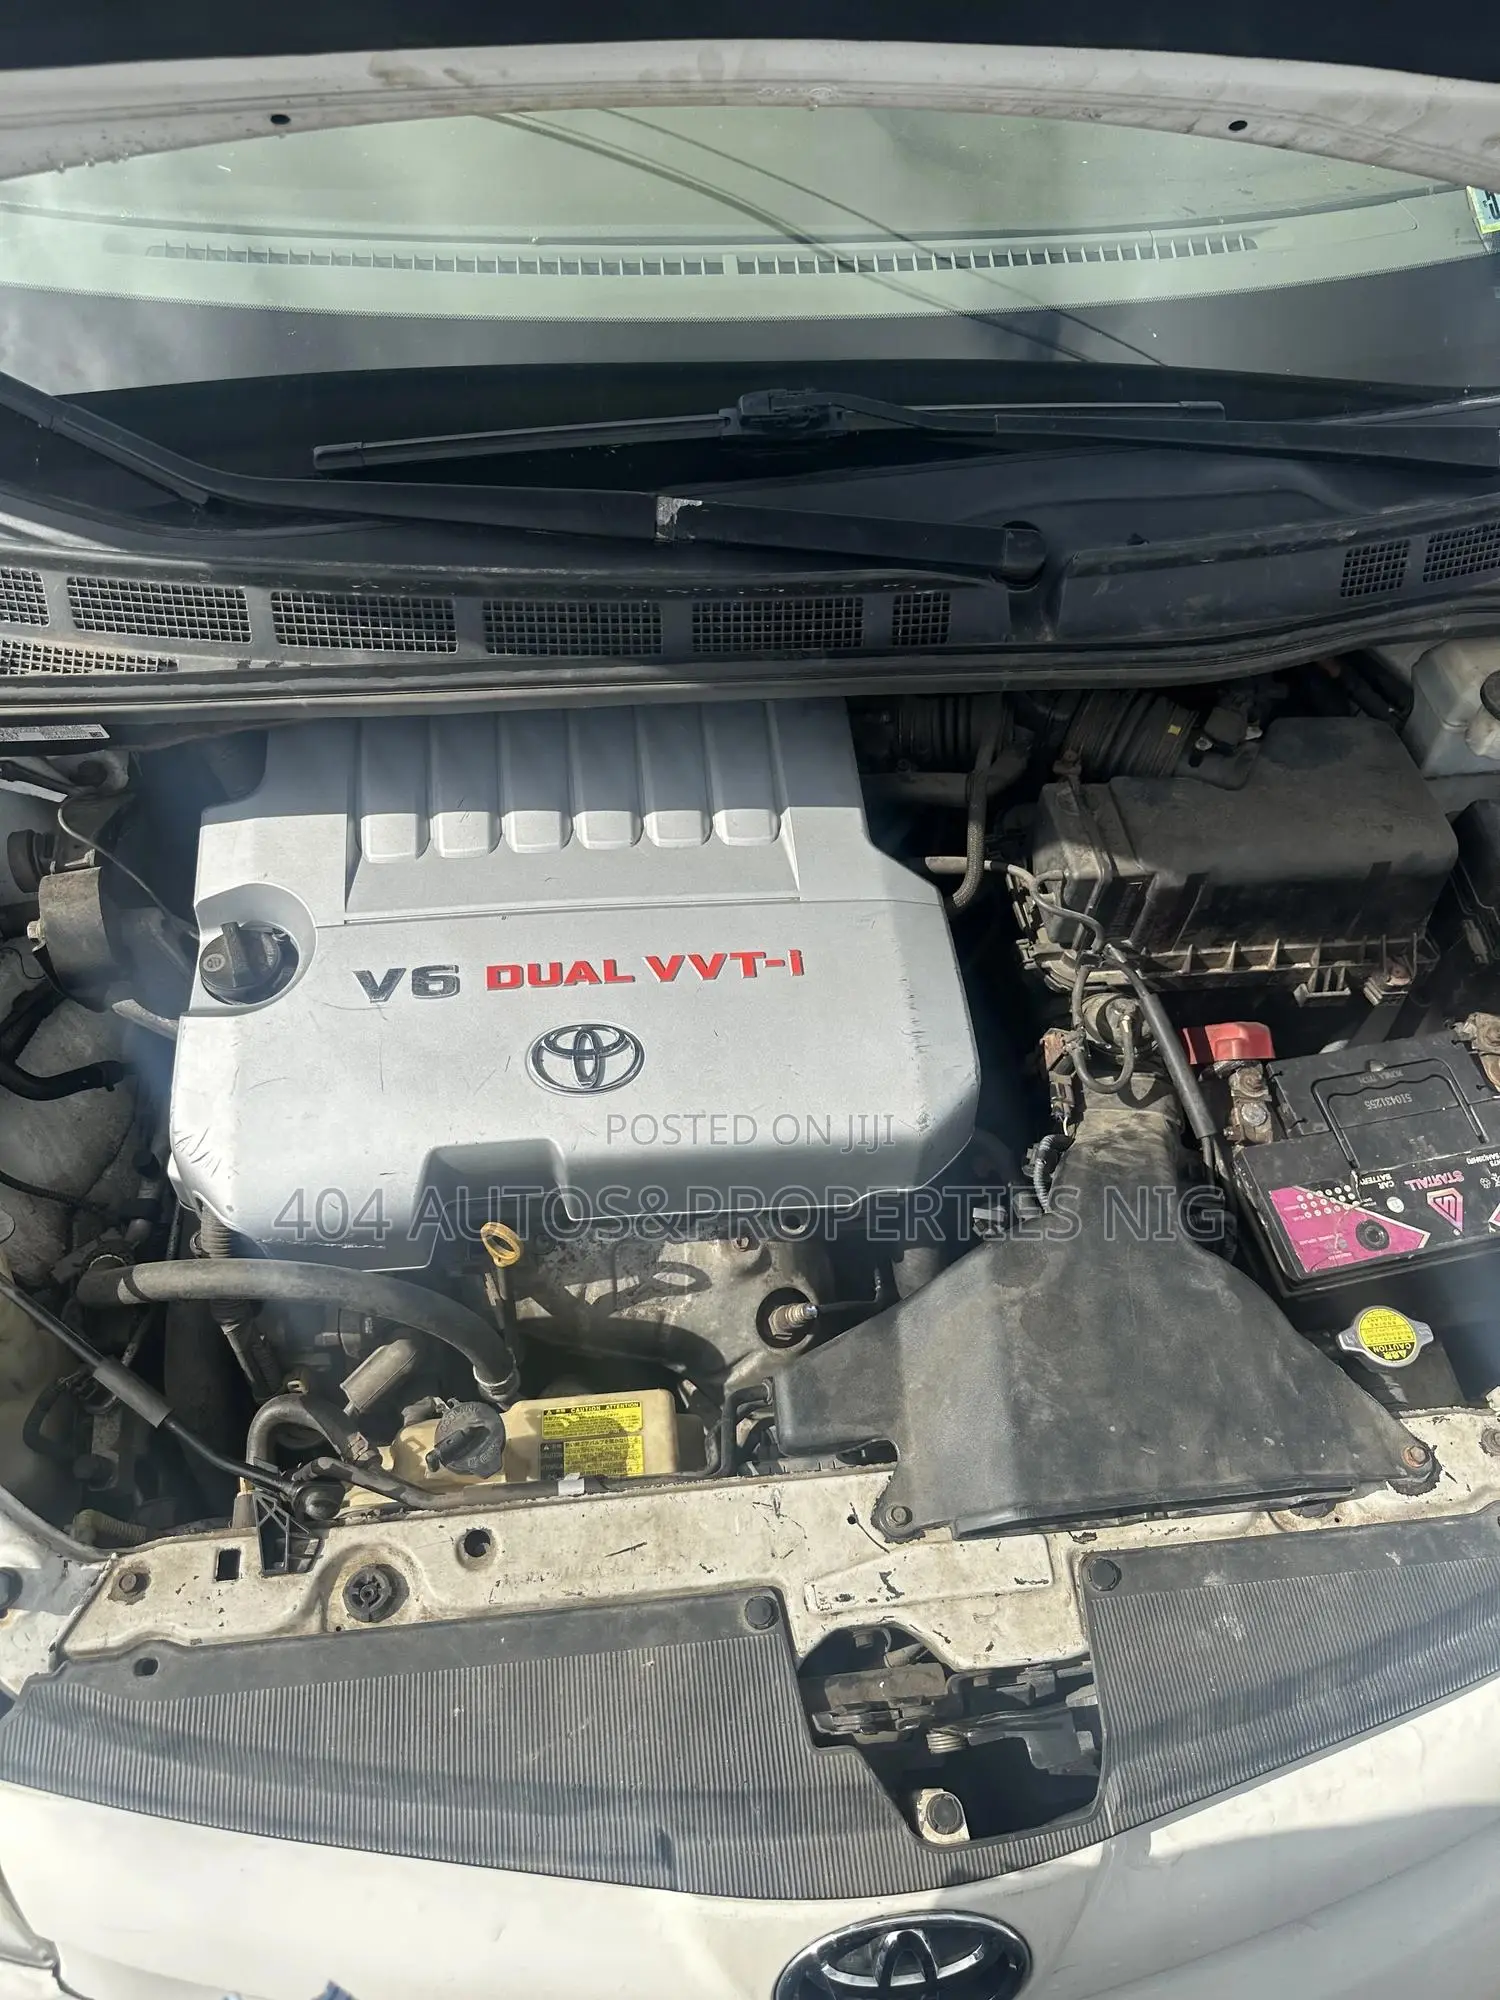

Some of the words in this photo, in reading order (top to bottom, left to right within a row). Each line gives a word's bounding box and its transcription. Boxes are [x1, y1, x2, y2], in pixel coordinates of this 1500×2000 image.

[352, 964, 460, 1004] V6
[486, 959, 635, 991] DUAL
[1360, 1173, 1393, 1186] BATTERY
[1378, 1180, 1395, 1190] CAR
[1404, 1170, 1465, 1191] STARTALL
[1373, 1342, 1412, 1353] CAUTION
[570, 1405, 601, 1414] CAUTION
[605, 1402, 640, 1411] ATTENTION
